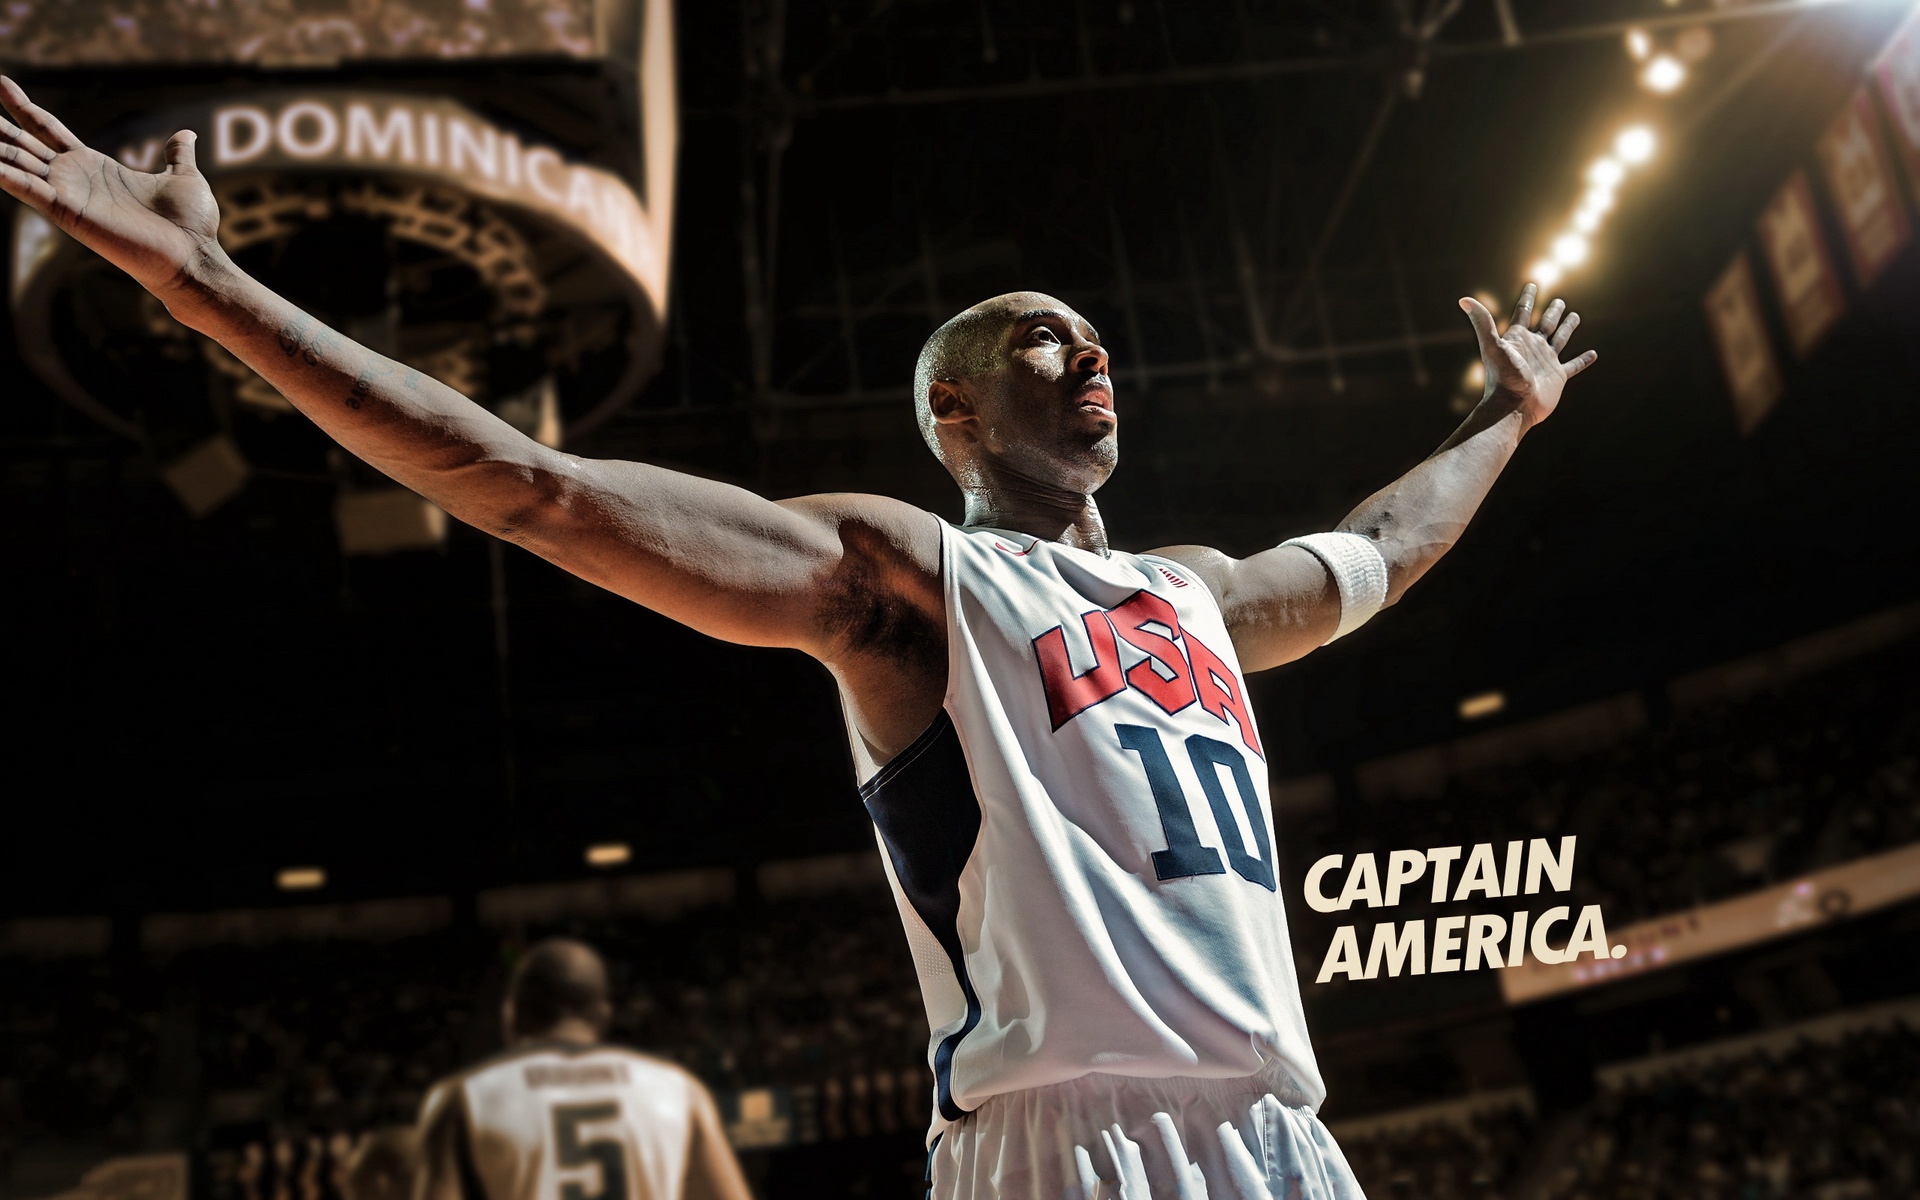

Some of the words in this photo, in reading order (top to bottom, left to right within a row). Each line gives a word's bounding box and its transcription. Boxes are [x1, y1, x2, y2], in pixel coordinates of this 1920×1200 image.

[1032, 588, 1266, 763] USA
[1114, 723, 1277, 893] 10
[551, 1101, 631, 1200] 5
